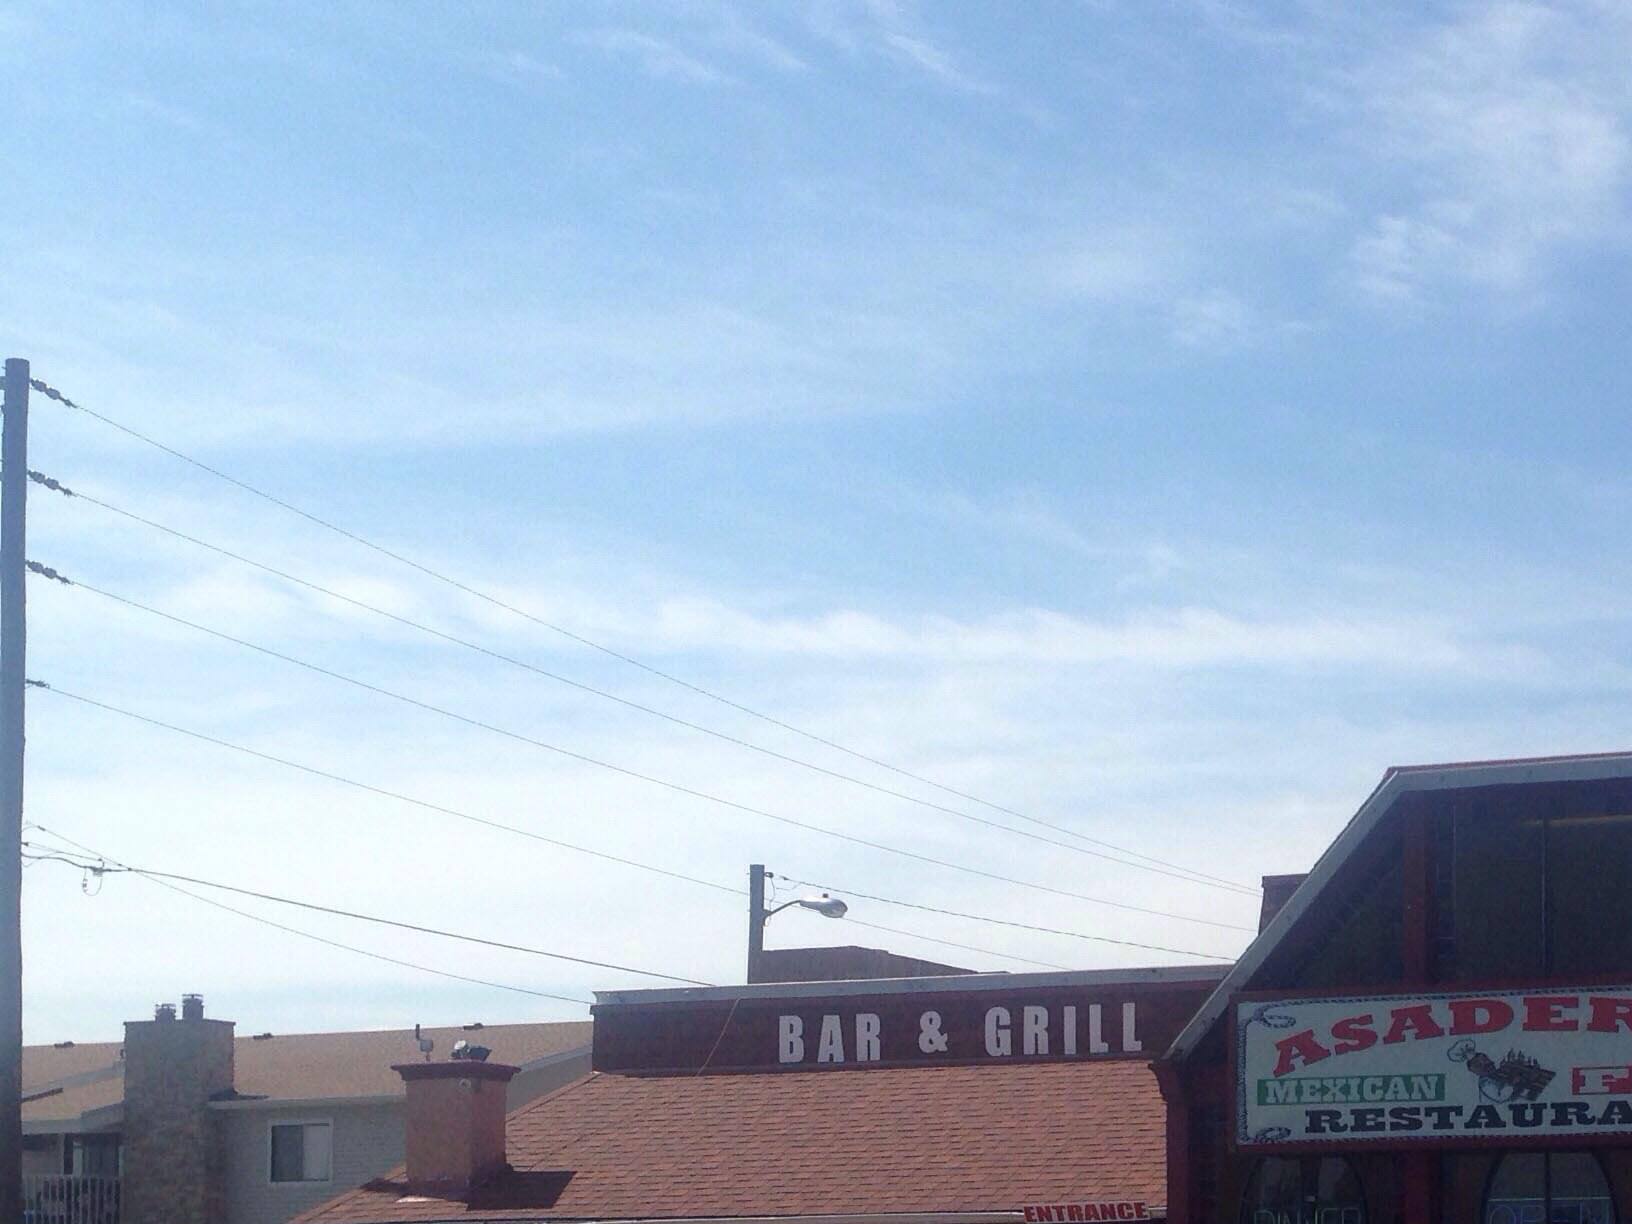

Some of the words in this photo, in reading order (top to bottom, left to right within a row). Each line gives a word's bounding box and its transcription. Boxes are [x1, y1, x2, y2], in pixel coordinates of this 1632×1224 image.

[779, 1013, 881, 1063] BAR
[918, 1010, 948, 1053] &
[985, 1003, 1142, 1057] GRILL
[1264, 1074, 1438, 1102] MEXICAN
[1024, 1201, 1148, 1222] ENTRANCE
